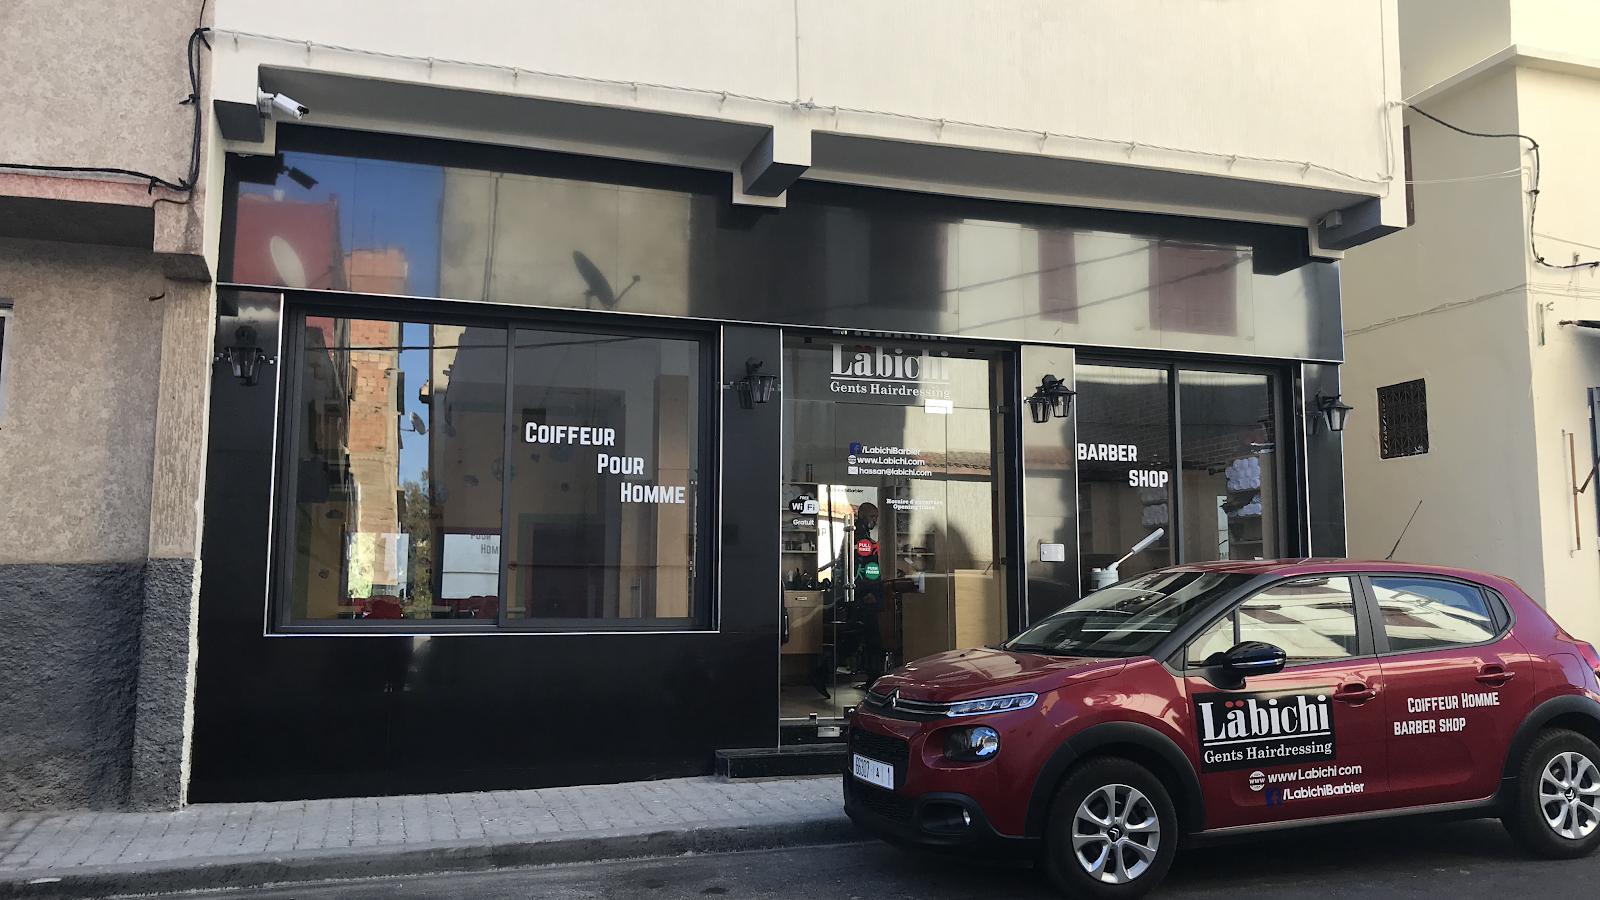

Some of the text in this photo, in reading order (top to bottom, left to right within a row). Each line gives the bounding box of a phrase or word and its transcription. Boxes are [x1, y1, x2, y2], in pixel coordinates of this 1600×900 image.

[830, 381, 951, 399] Gents Hairdressing
[525, 421, 616, 447] COIFFEUR
[857, 456, 926, 466] www.Labichi.com
[1077, 443, 1138, 462] BARBER
[597, 453, 645, 475] POUR
[859, 466, 932, 477] hassan@labichi.com
[1128, 469, 1169, 488] SHOP
[620, 481, 686, 504] HOMME
[1407, 691, 1500, 713] COIFFEUR HOMME
[1393, 717, 1467, 736] BARBER SHOP
[1203, 741, 1333, 764] Gents Hairdressing
